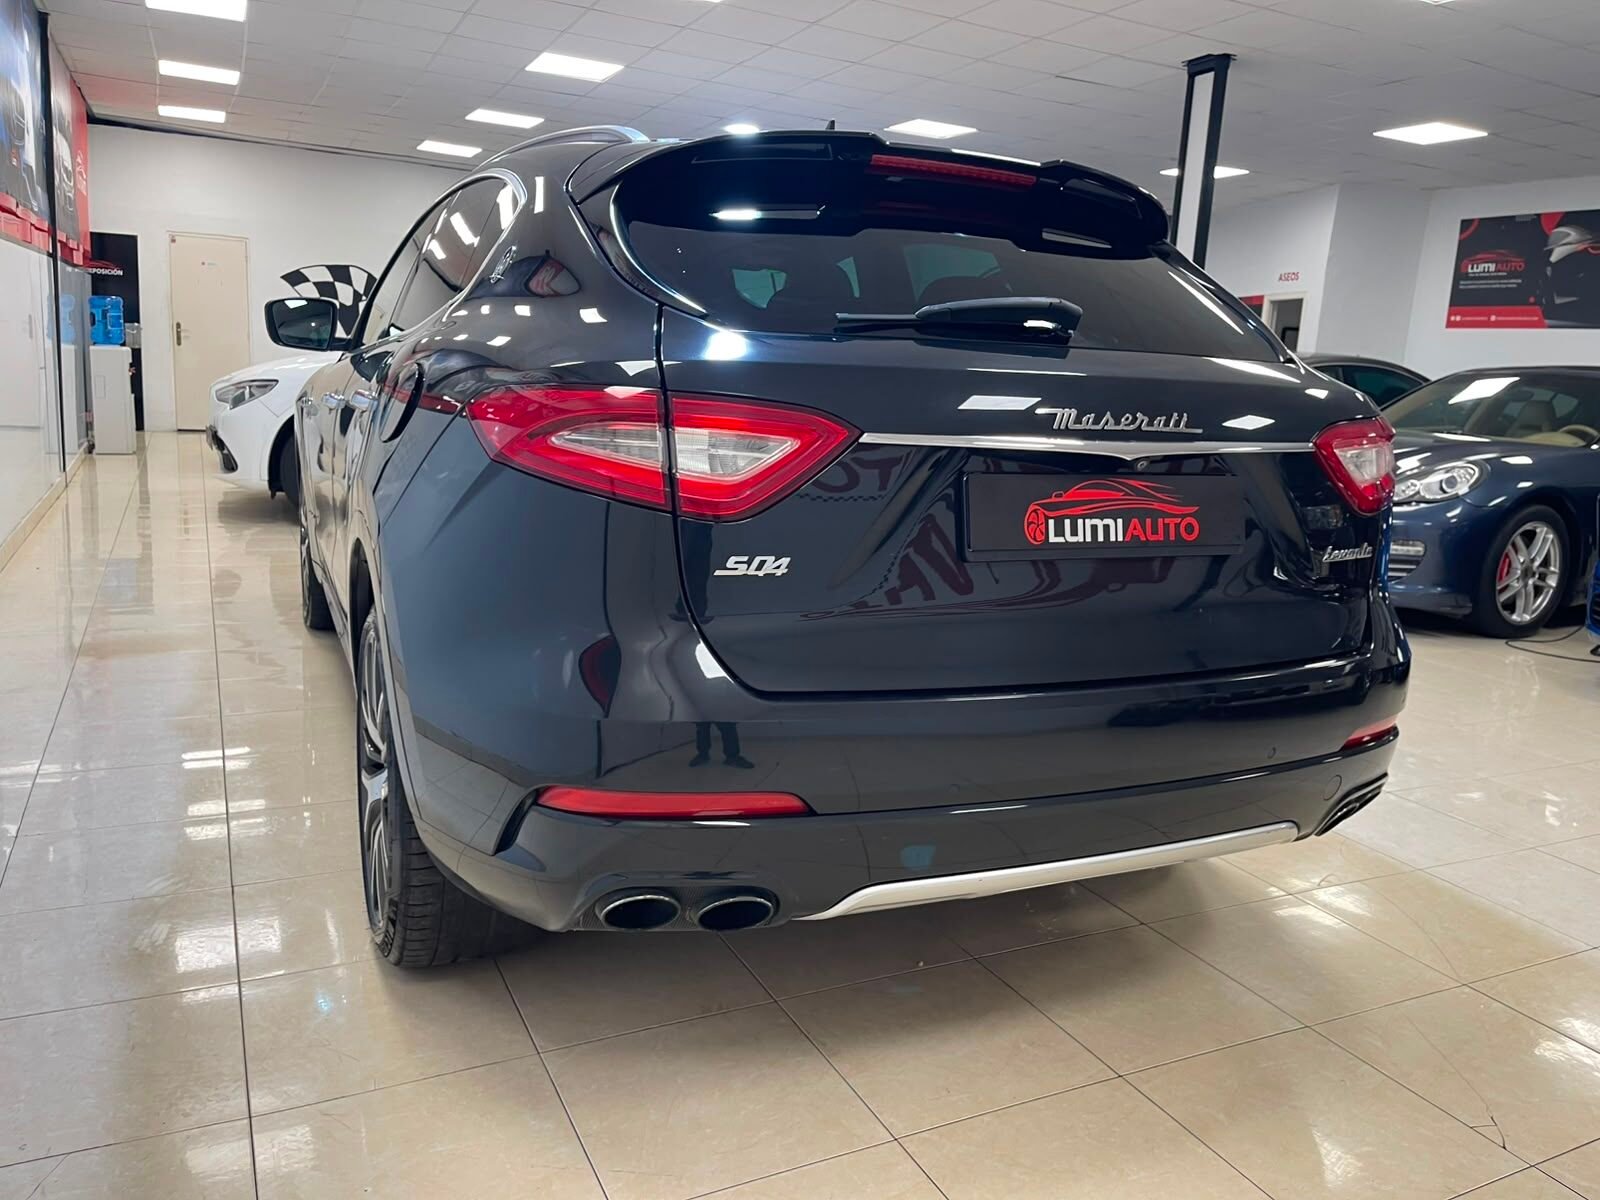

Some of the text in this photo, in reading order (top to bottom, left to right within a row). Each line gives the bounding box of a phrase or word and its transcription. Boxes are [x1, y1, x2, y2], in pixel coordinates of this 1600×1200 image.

[1278, 271, 1300, 282] ASEOS
[1467, 262, 1526, 273] LUMIAUTO
[1035, 408, 1203, 433] Maserati
[1048, 516, 1200, 543] LUMIAUTO
[713, 555, 791, 577] SQ4
